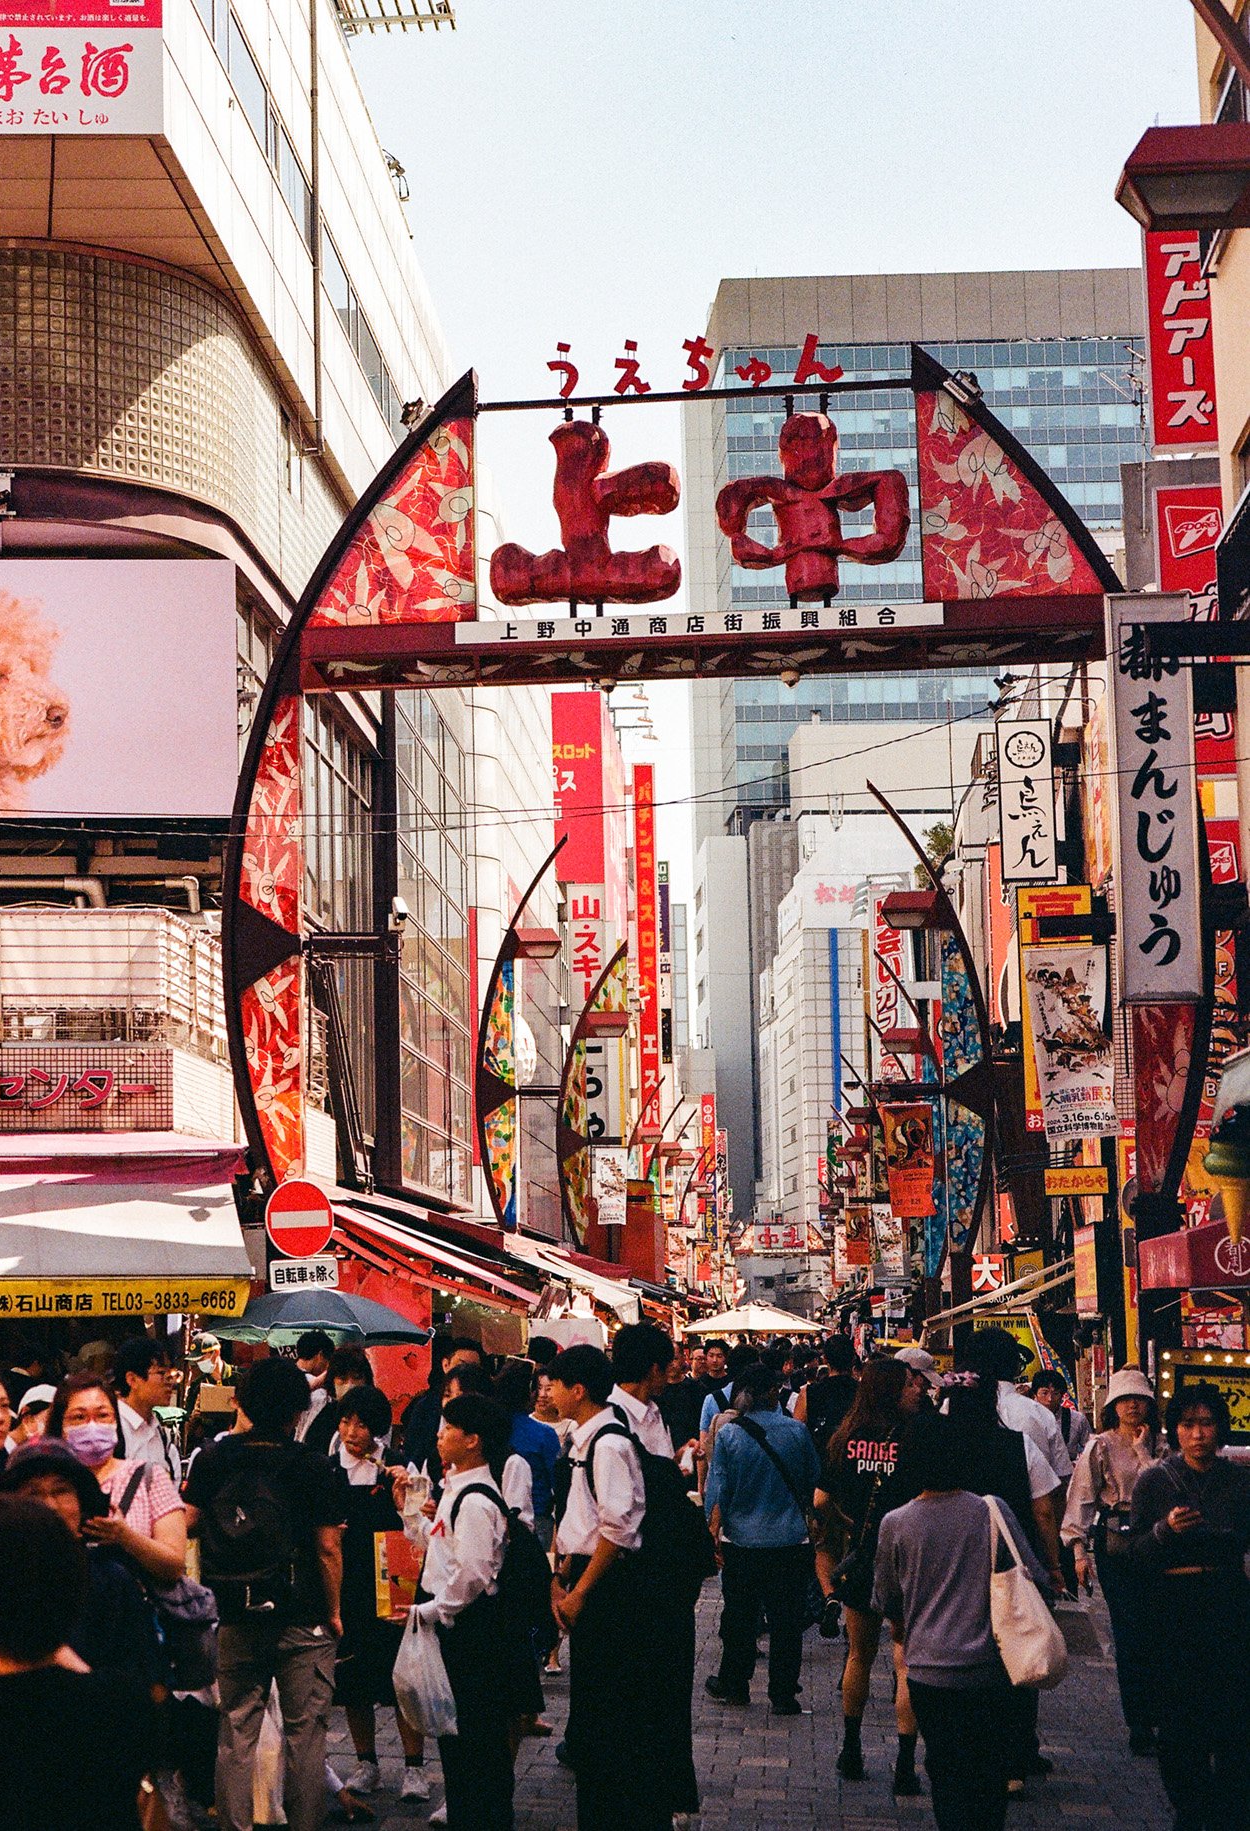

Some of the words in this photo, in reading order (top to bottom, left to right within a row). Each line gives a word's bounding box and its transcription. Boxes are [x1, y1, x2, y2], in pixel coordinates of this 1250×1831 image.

[1160, 241, 1214, 427] アドアーズ
[547, 333, 844, 399] うえちゅん
[500, 606, 897, 641] 上野中通商店街振興組合
[275, 1265, 335, 1284] 自転車を除く
